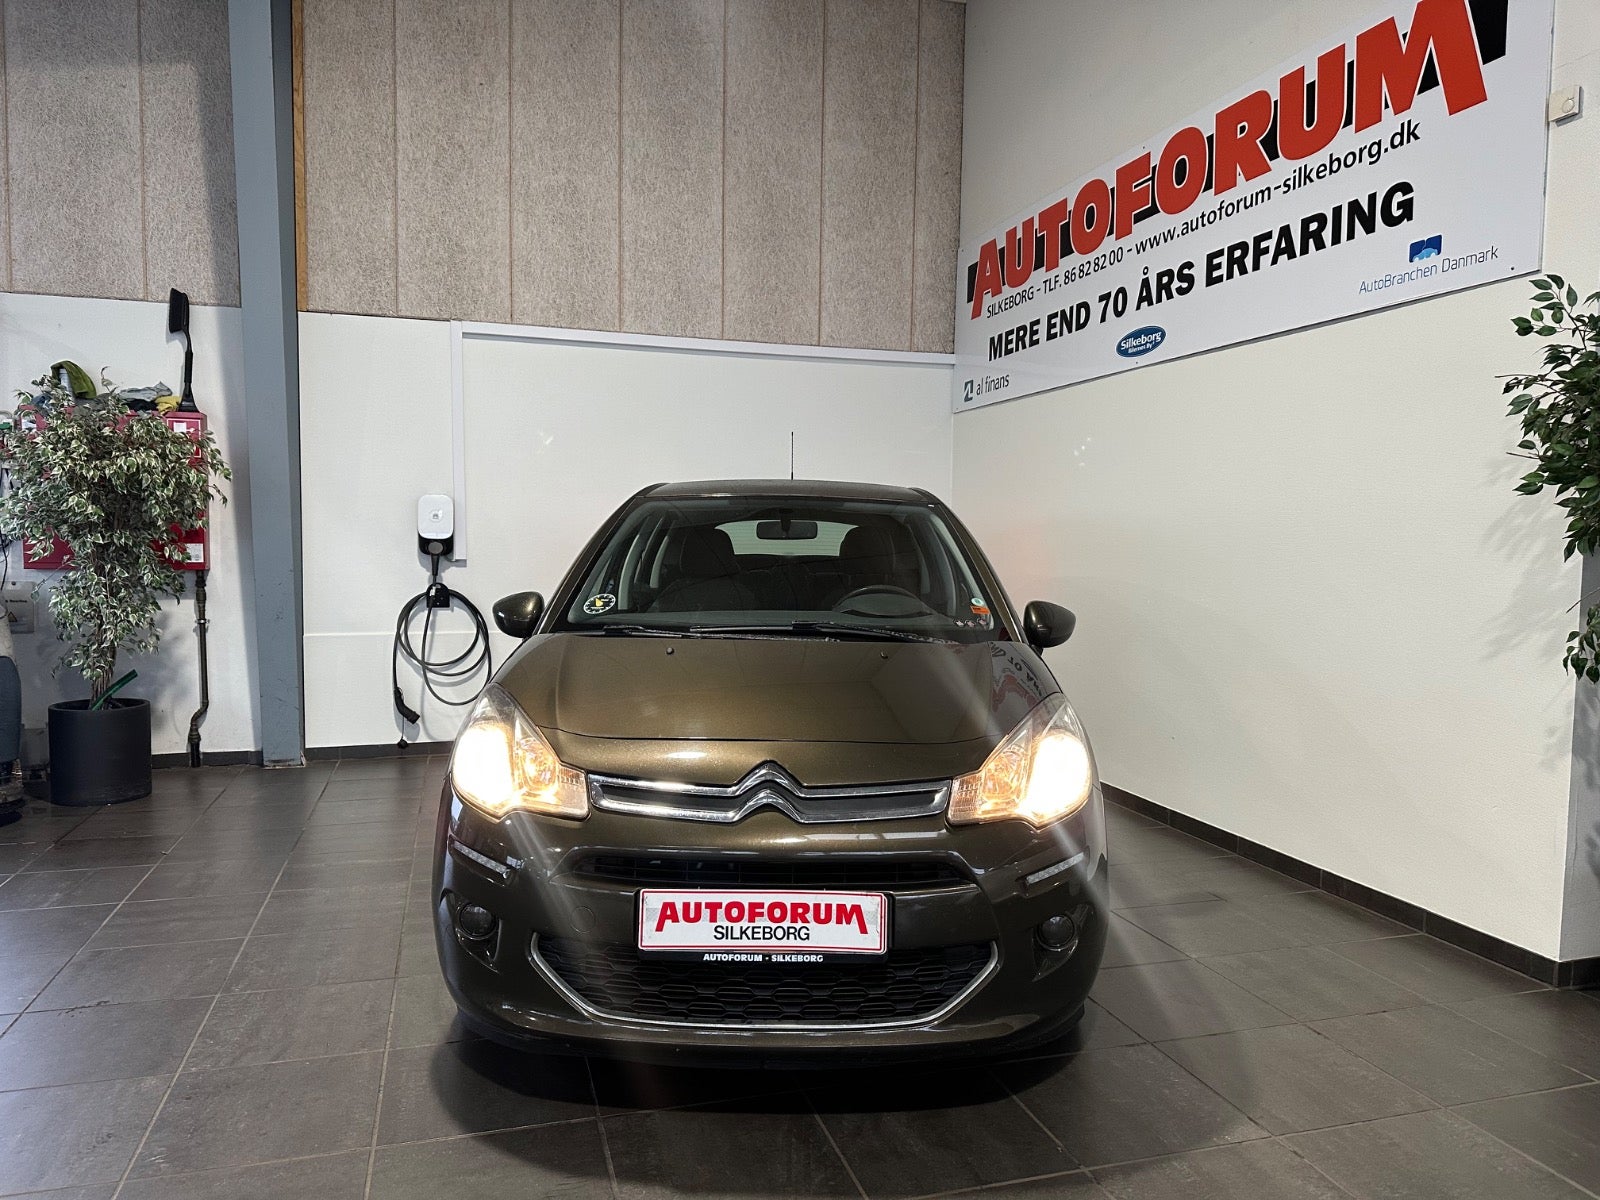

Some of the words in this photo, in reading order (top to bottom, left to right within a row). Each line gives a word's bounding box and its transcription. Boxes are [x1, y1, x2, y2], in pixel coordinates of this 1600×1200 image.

[971, 0, 1487, 320] AUTOFORUM
[987, 286, 1034, 318] SILKEBORG
[1043, 274, 1062, 295] TLF.
[1135, 118, 1421, 255] www.autoforum-silkeborg.dk
[988, 318, 1040, 362] MERE
[1045, 301, 1091, 341] END
[1098, 286, 1128, 324] 70
[1135, 260, 1195, 311] ÅRS
[1205, 181, 1414, 288] ERFARING
[1359, 264, 1438, 295] AutoBranchen
[1441, 245, 1499, 273] Danmark
[1120, 331, 1162, 350] Silkeborg
[976, 377, 984, 396] al
[985, 373, 1010, 393] finans
[655, 901, 869, 935] AUTOFORUM
[713, 925, 810, 941] SILKEBORG
[703, 953, 763, 962] AUTOFORUM
[771, 954, 824, 962] SILKEBORG
